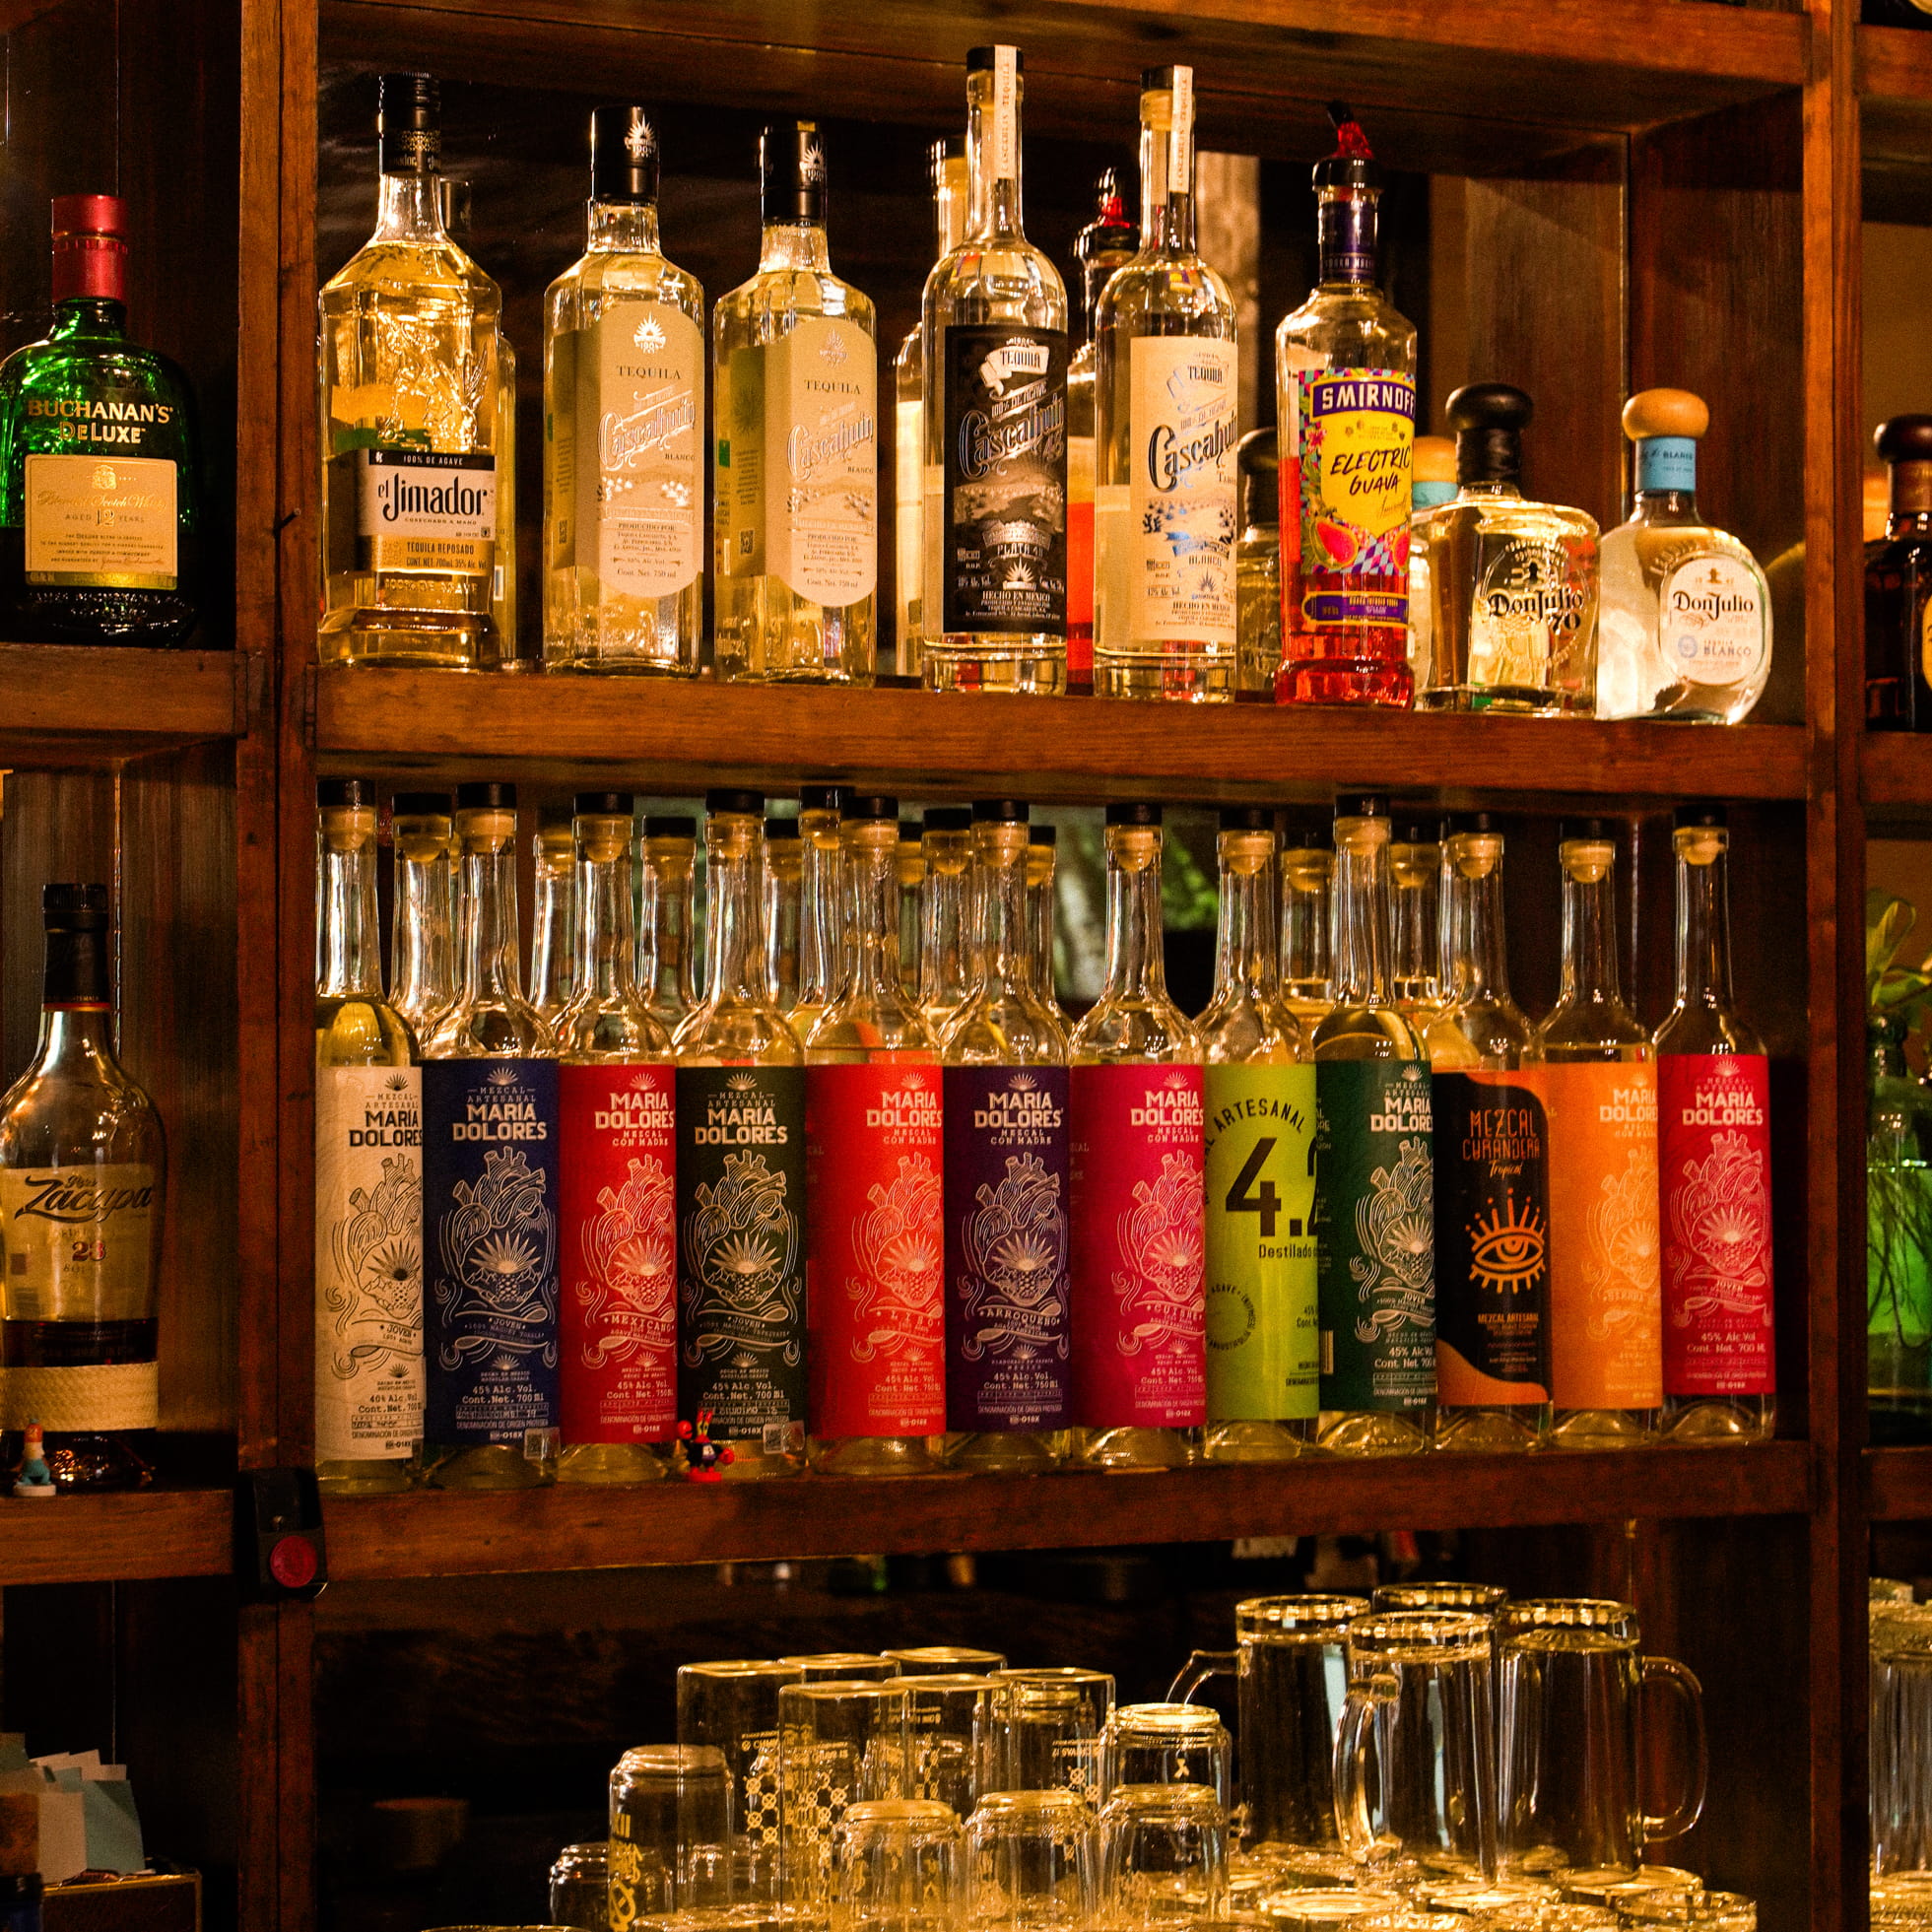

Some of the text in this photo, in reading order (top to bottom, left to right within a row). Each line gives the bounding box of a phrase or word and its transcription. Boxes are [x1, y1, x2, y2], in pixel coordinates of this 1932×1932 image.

[1000, 350, 1040, 368] TEQUILA
[615, 366, 682, 380] TEQUILA
[1187, 365, 1223, 383] TEQUILA
[803, 378, 861, 394] TEQUILA
[1321, 382, 1416, 416] SMIRNOFF
[29, 400, 171, 424] BUCHANAN'S
[59, 422, 142, 444] DELUXE
[403, 455, 463, 466] 100% DE AGAVE
[664, 453, 696, 462] BLANCO
[1330, 445, 1411, 476] ELECTRIC
[1349, 472, 1401, 497] GUAVA
[91, 494, 127, 508] Scotch
[382, 472, 489, 522] Jimador
[96, 509, 115, 527] 12
[407, 542, 474, 555] TEQUILA REPOSADO
[997, 543, 1031, 556] PLATA
[982, 590, 1012, 600] HECHO
[1013, 590, 1024, 600] EN
[1549, 612, 1581, 633] 70
[1703, 645, 1752, 656] BLANCO
[480, 1086, 526, 1095] MEZCAL
[718, 1091, 765, 1099] MEZCAL
[594, 1110, 675, 1130] DOLORES
[865, 1108, 943, 1128] DOLORES
[973, 1109, 1062, 1129] DOLORES
[1130, 1107, 1204, 1127] DOLORES
[1213, 1097, 1306, 1135] ARTESANAL
[1469, 1108, 1538, 1140] MEZCAL
[1682, 1107, 1764, 1126] DOLORES
[452, 1121, 548, 1142] DOLORES
[695, 1125, 789, 1146] DOLORES
[1147, 1134, 1168, 1144] CON
[612, 1138, 634, 1147] CON
[882, 1136, 905, 1146] CON
[990, 1136, 1014, 1146] CON
[1461, 1138, 1541, 1163] CURANDERA
[14, 1175, 154, 1224] Zacapa
[71, 1240, 107, 1262] 23
[1258, 1243, 1312, 1260] Destilado
[1211, 1283, 1236, 1294] AGAVE
[494, 1318, 521, 1330] JOVEN
[611, 1314, 672, 1333] MEXICANO
[1477, 1312, 1505, 1324] MEZCAL
[386, 1323, 413, 1338] JOVEN
[1700, 1331, 1722, 1342] 45%
[516, 1393, 533, 1403] 700
